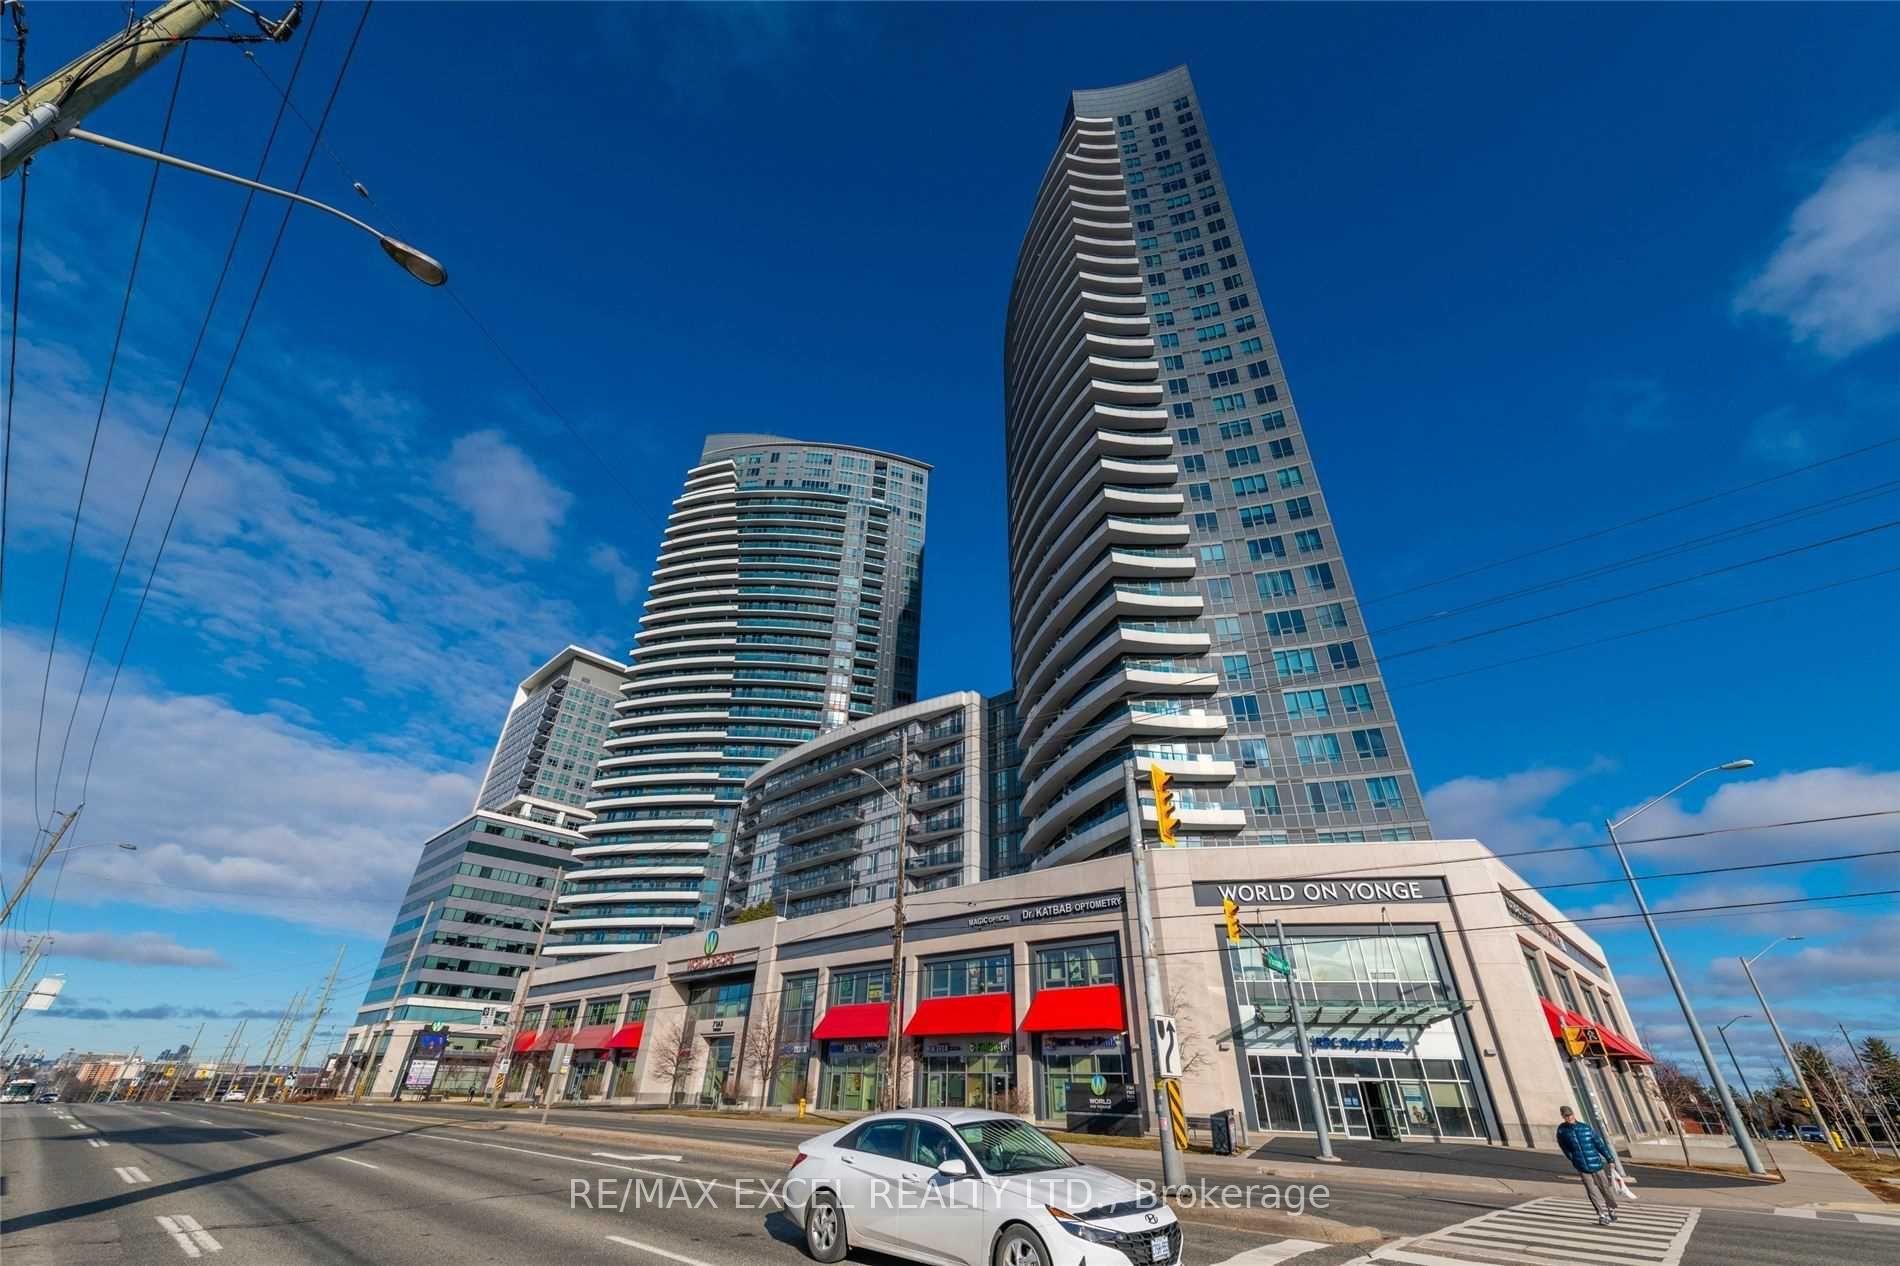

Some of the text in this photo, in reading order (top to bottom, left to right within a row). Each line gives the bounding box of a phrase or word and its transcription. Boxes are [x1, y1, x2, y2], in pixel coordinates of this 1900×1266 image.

[1218, 882, 1423, 901] WORLD ON YONGE
[1036, 903, 1073, 918] KATBAB
[1074, 896, 1122, 911] OPTOMETRY
